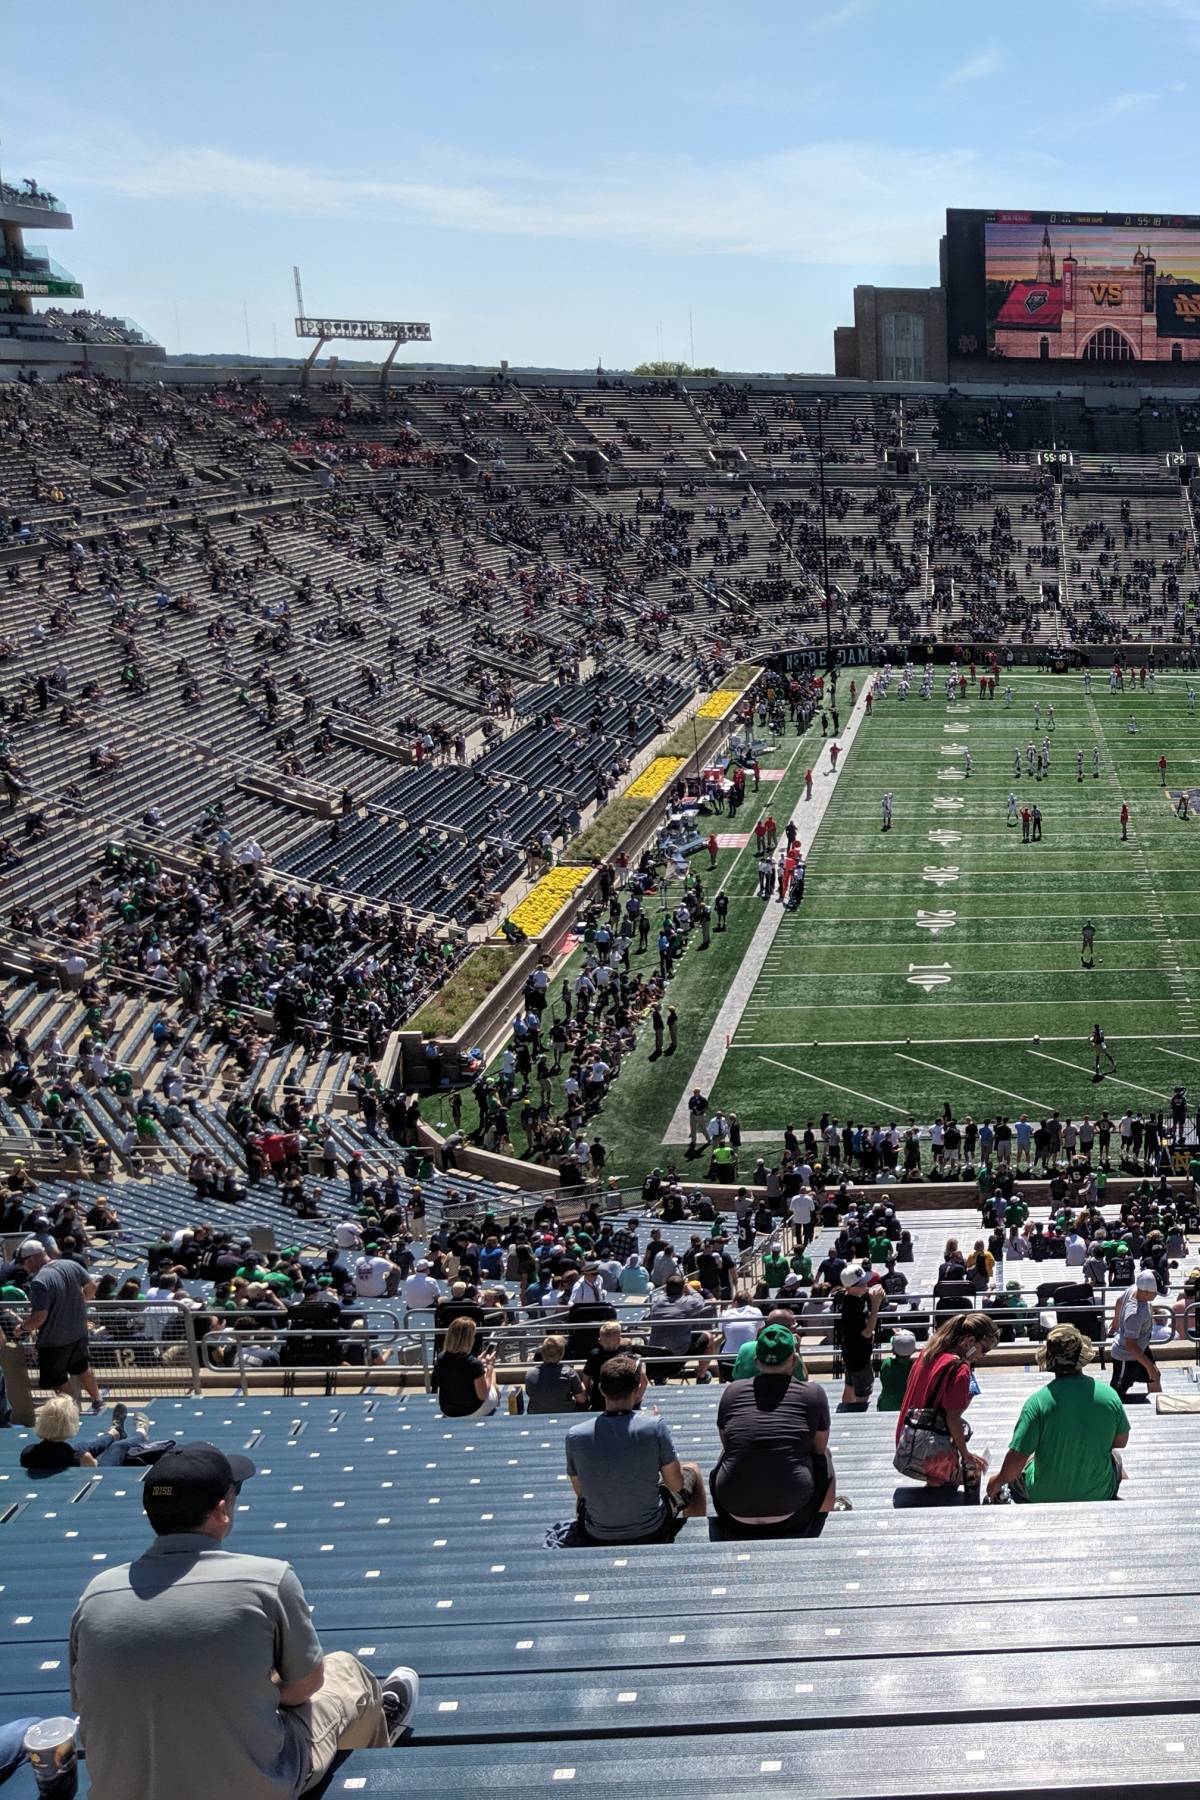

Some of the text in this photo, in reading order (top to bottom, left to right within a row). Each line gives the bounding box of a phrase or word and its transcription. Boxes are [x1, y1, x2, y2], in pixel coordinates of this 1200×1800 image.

[1088, 283, 1123, 306] VS
[1173, 454, 1185, 464] 25
[922, 865, 960, 882] 30
[915, 909, 957, 928] 20
[906, 961, 953, 984] 10
[152, 1486, 174, 1496] IRISH
